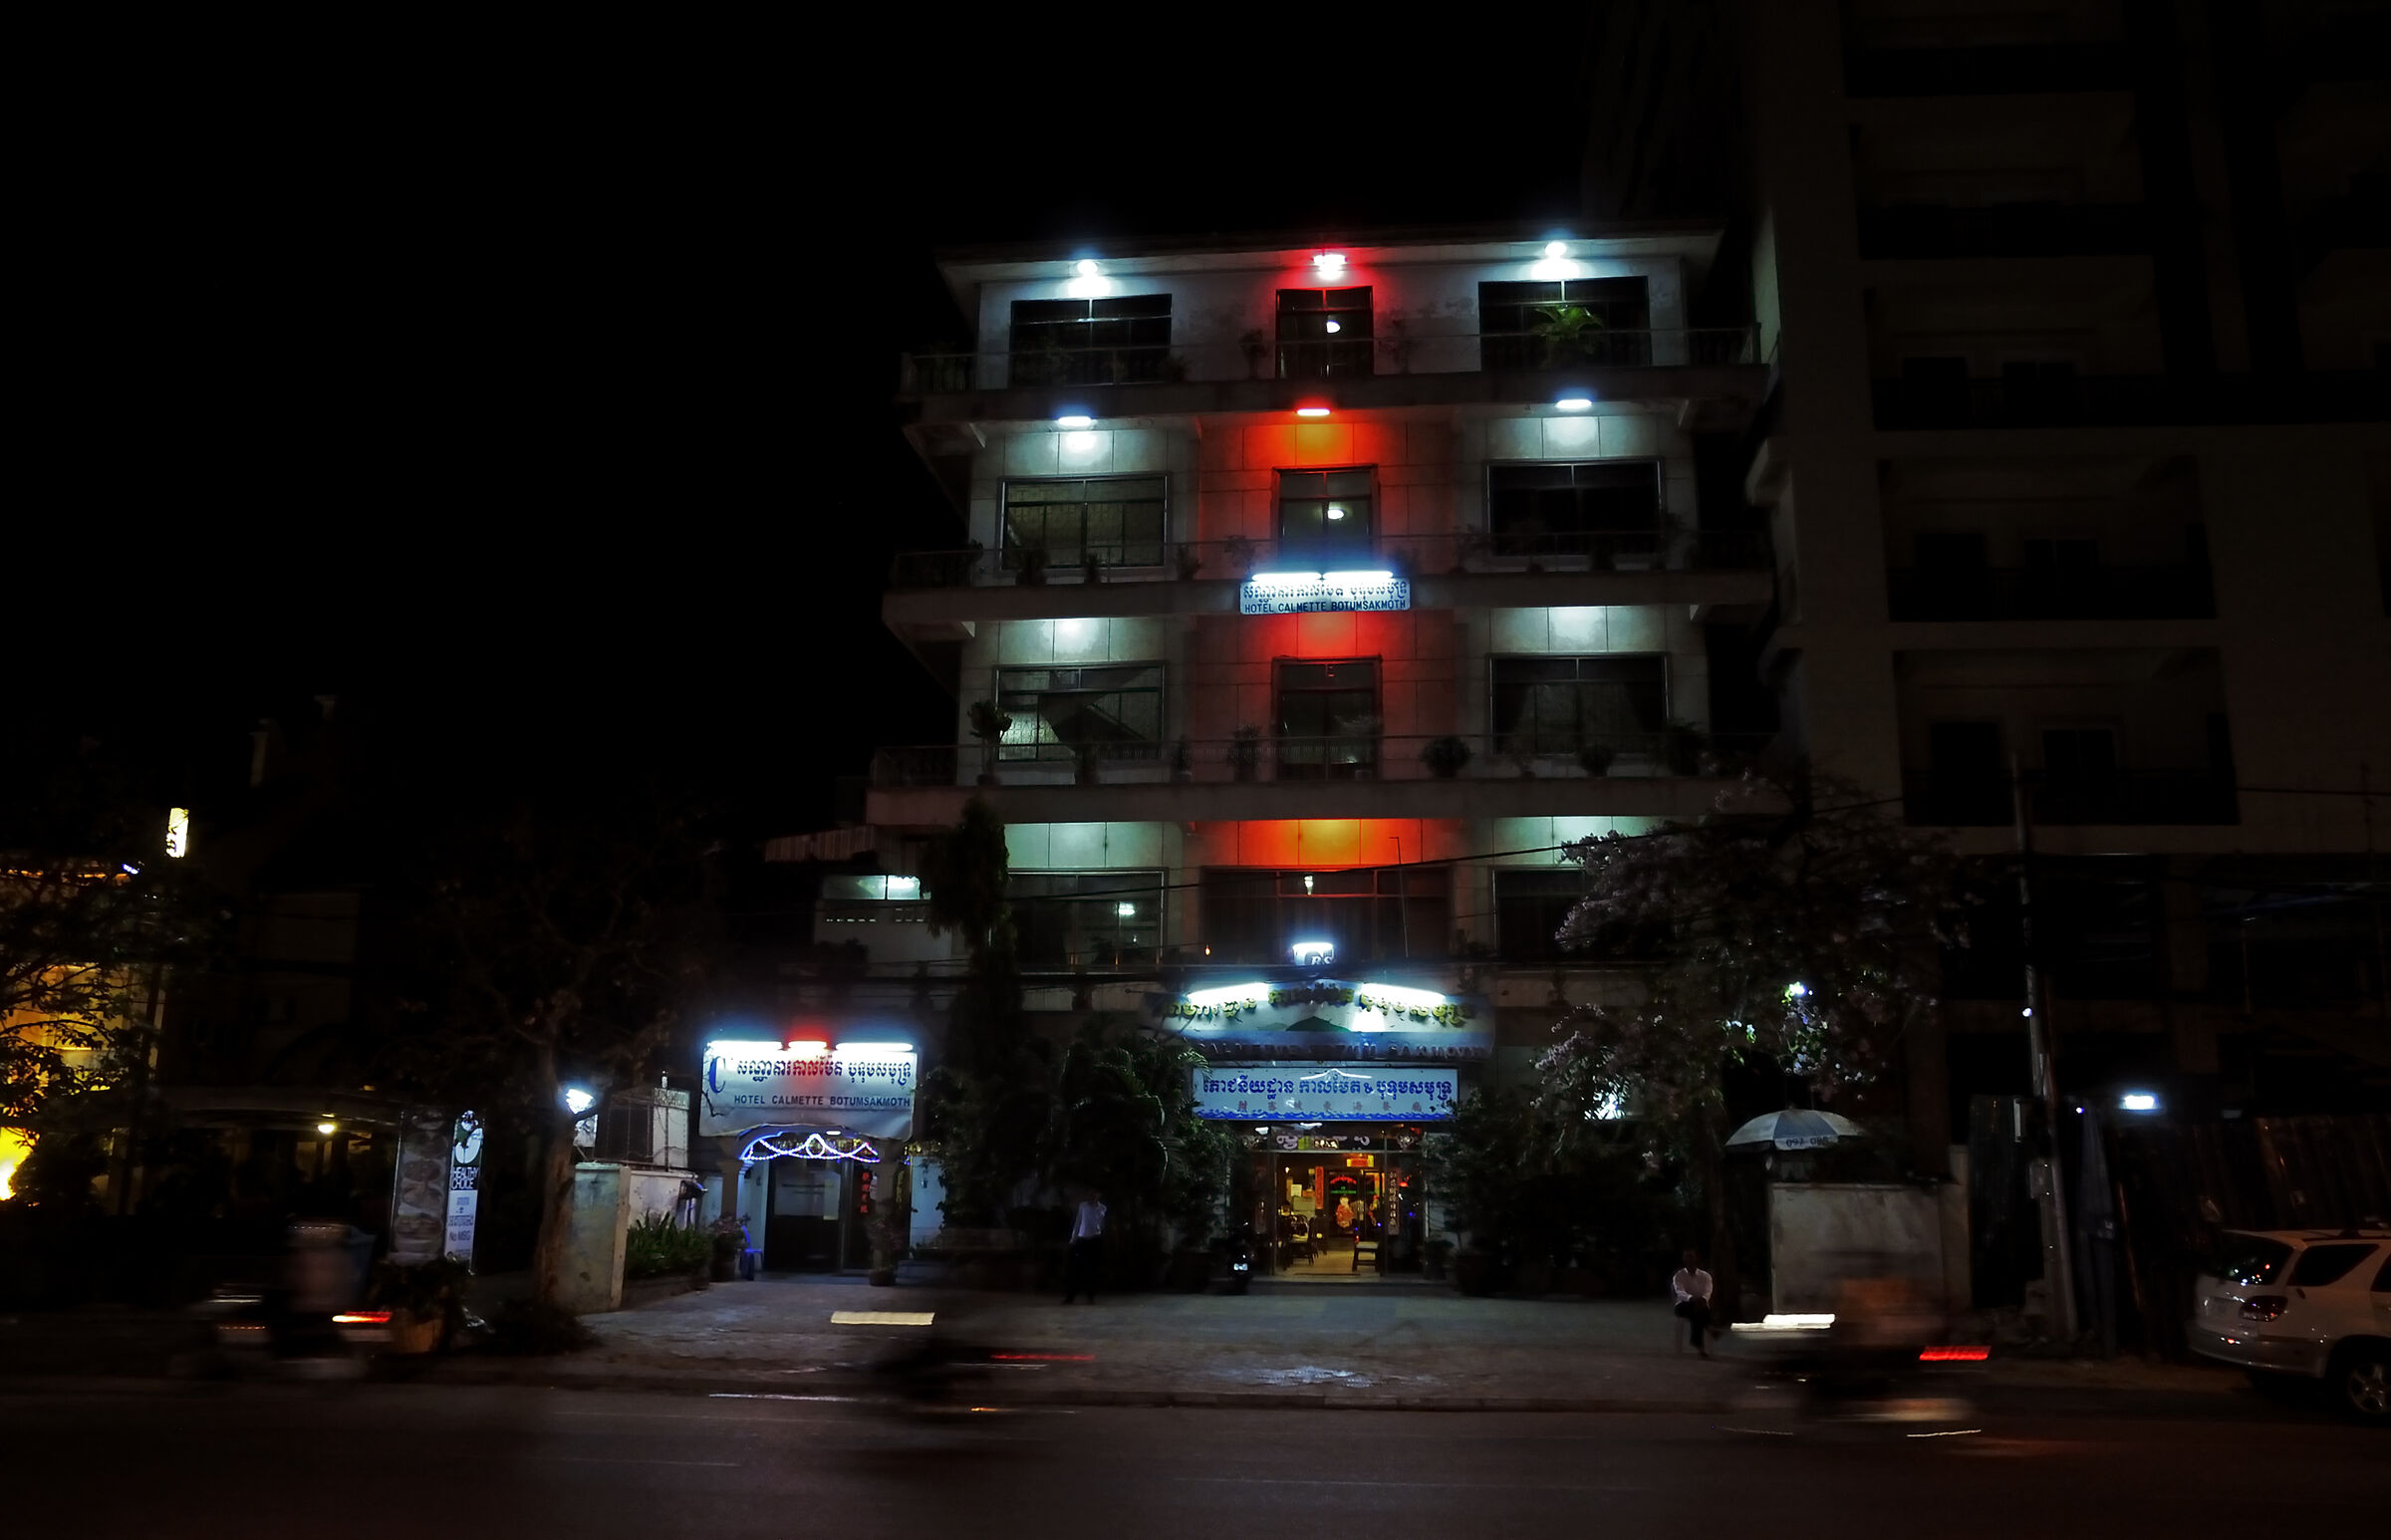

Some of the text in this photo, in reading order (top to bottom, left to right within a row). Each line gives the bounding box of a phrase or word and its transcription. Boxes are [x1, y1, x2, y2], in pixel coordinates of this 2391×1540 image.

[1244, 600, 1406, 613] HOTEL CALMETTE BOTUMSAKMOTH
[734, 1095, 911, 1107] HOTEL CALMETTE BOTUMSAKMOTH
[451, 1166, 478, 1178] HEALTHY
